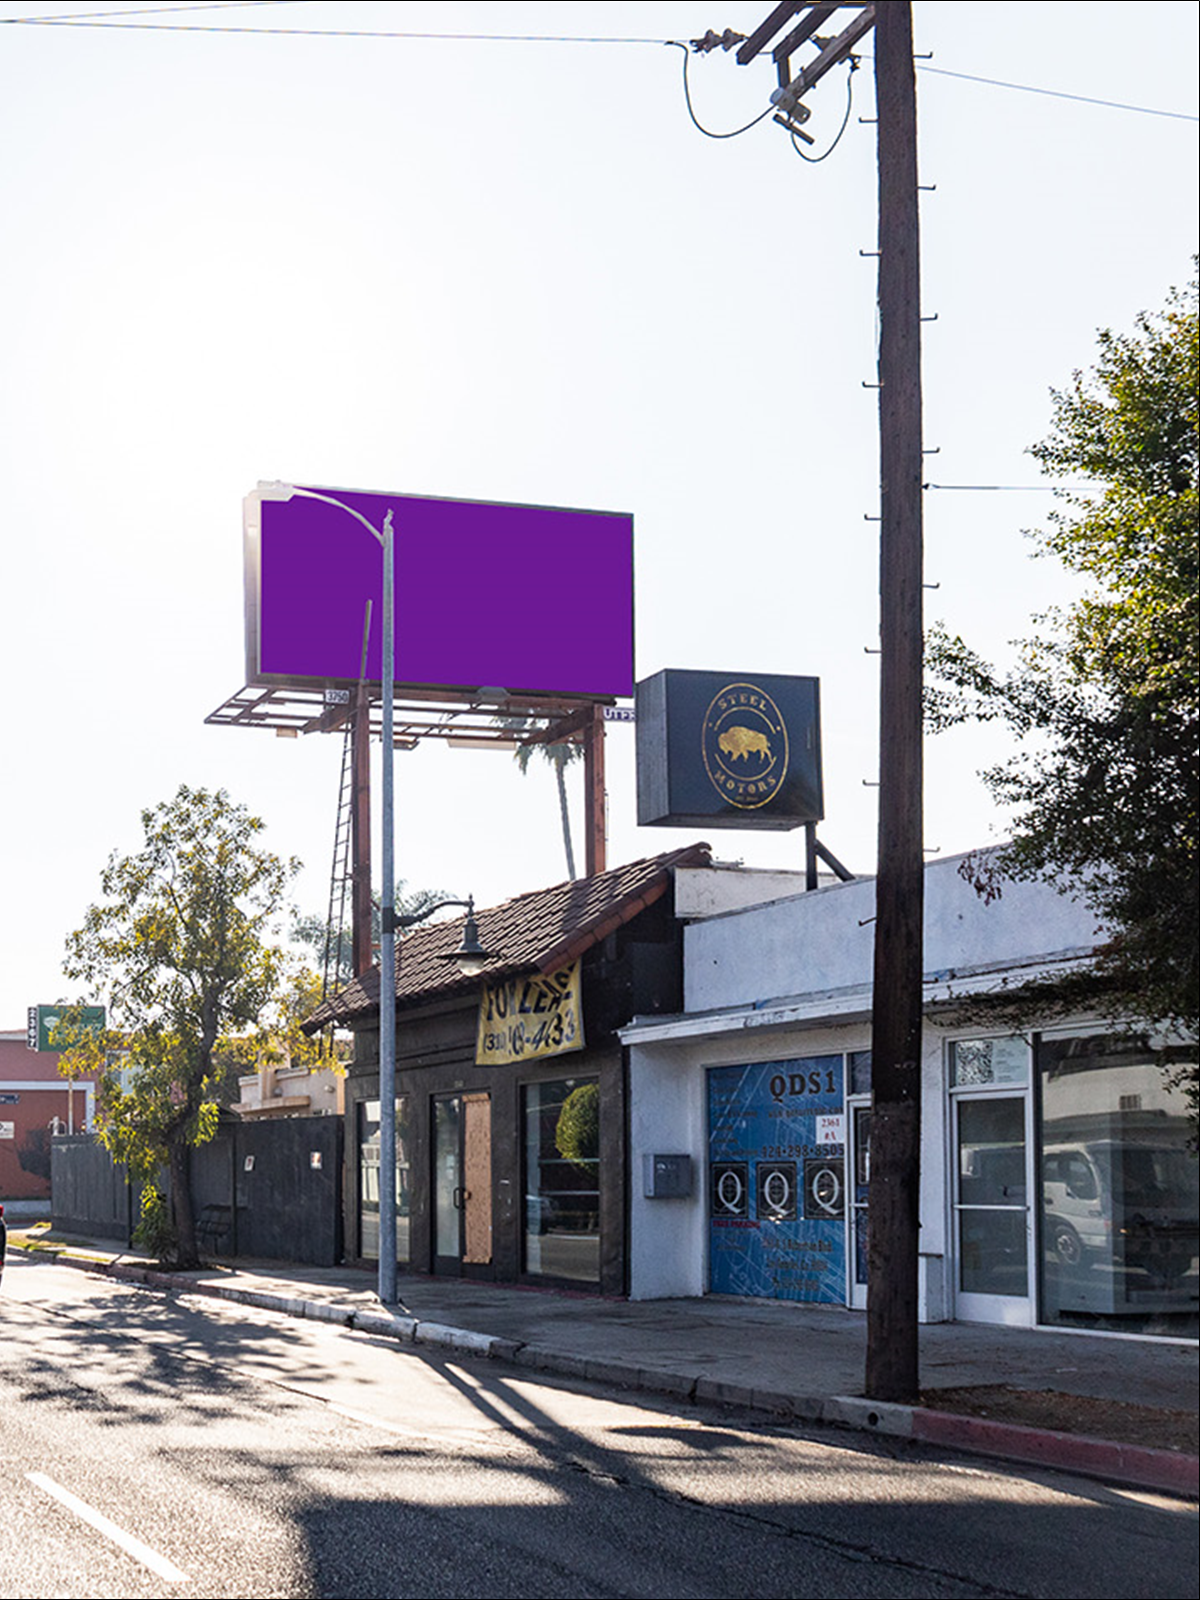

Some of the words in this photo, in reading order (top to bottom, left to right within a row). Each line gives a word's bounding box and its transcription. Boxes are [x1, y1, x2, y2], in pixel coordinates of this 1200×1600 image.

[718, 694, 766, 711] STEEL
[715, 770, 776, 794] MOTORS
[770, 1070, 836, 1103] QDS1
[718, 1171, 741, 1214] Q
[764, 1171, 789, 1215] Q
[813, 1169, 839, 1214] Q
